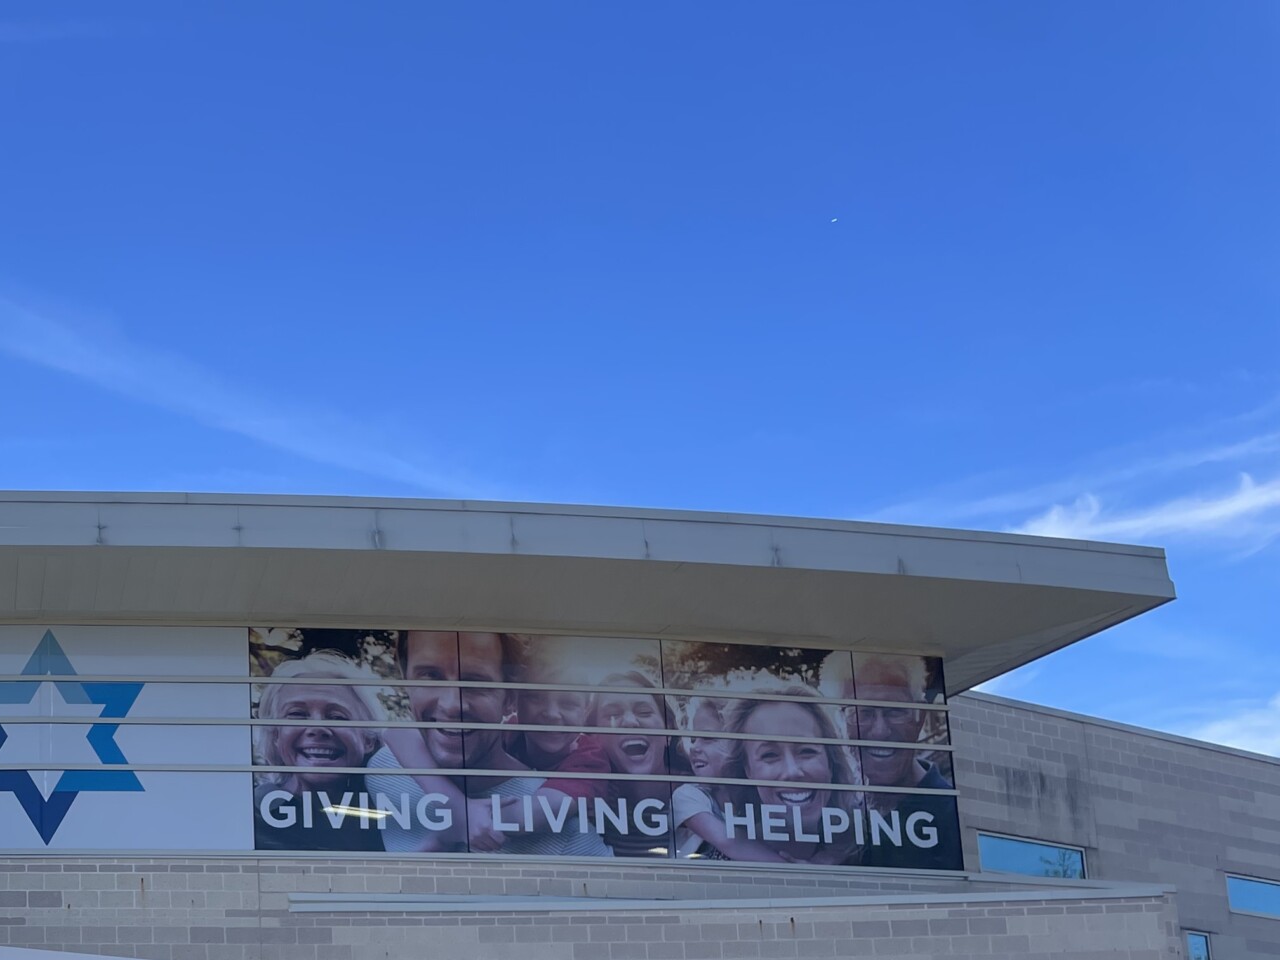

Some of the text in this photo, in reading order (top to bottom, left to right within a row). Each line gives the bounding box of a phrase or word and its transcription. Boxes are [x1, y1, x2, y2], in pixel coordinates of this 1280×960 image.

[260, 790, 939, 849] GIVING LIVING HELPING
